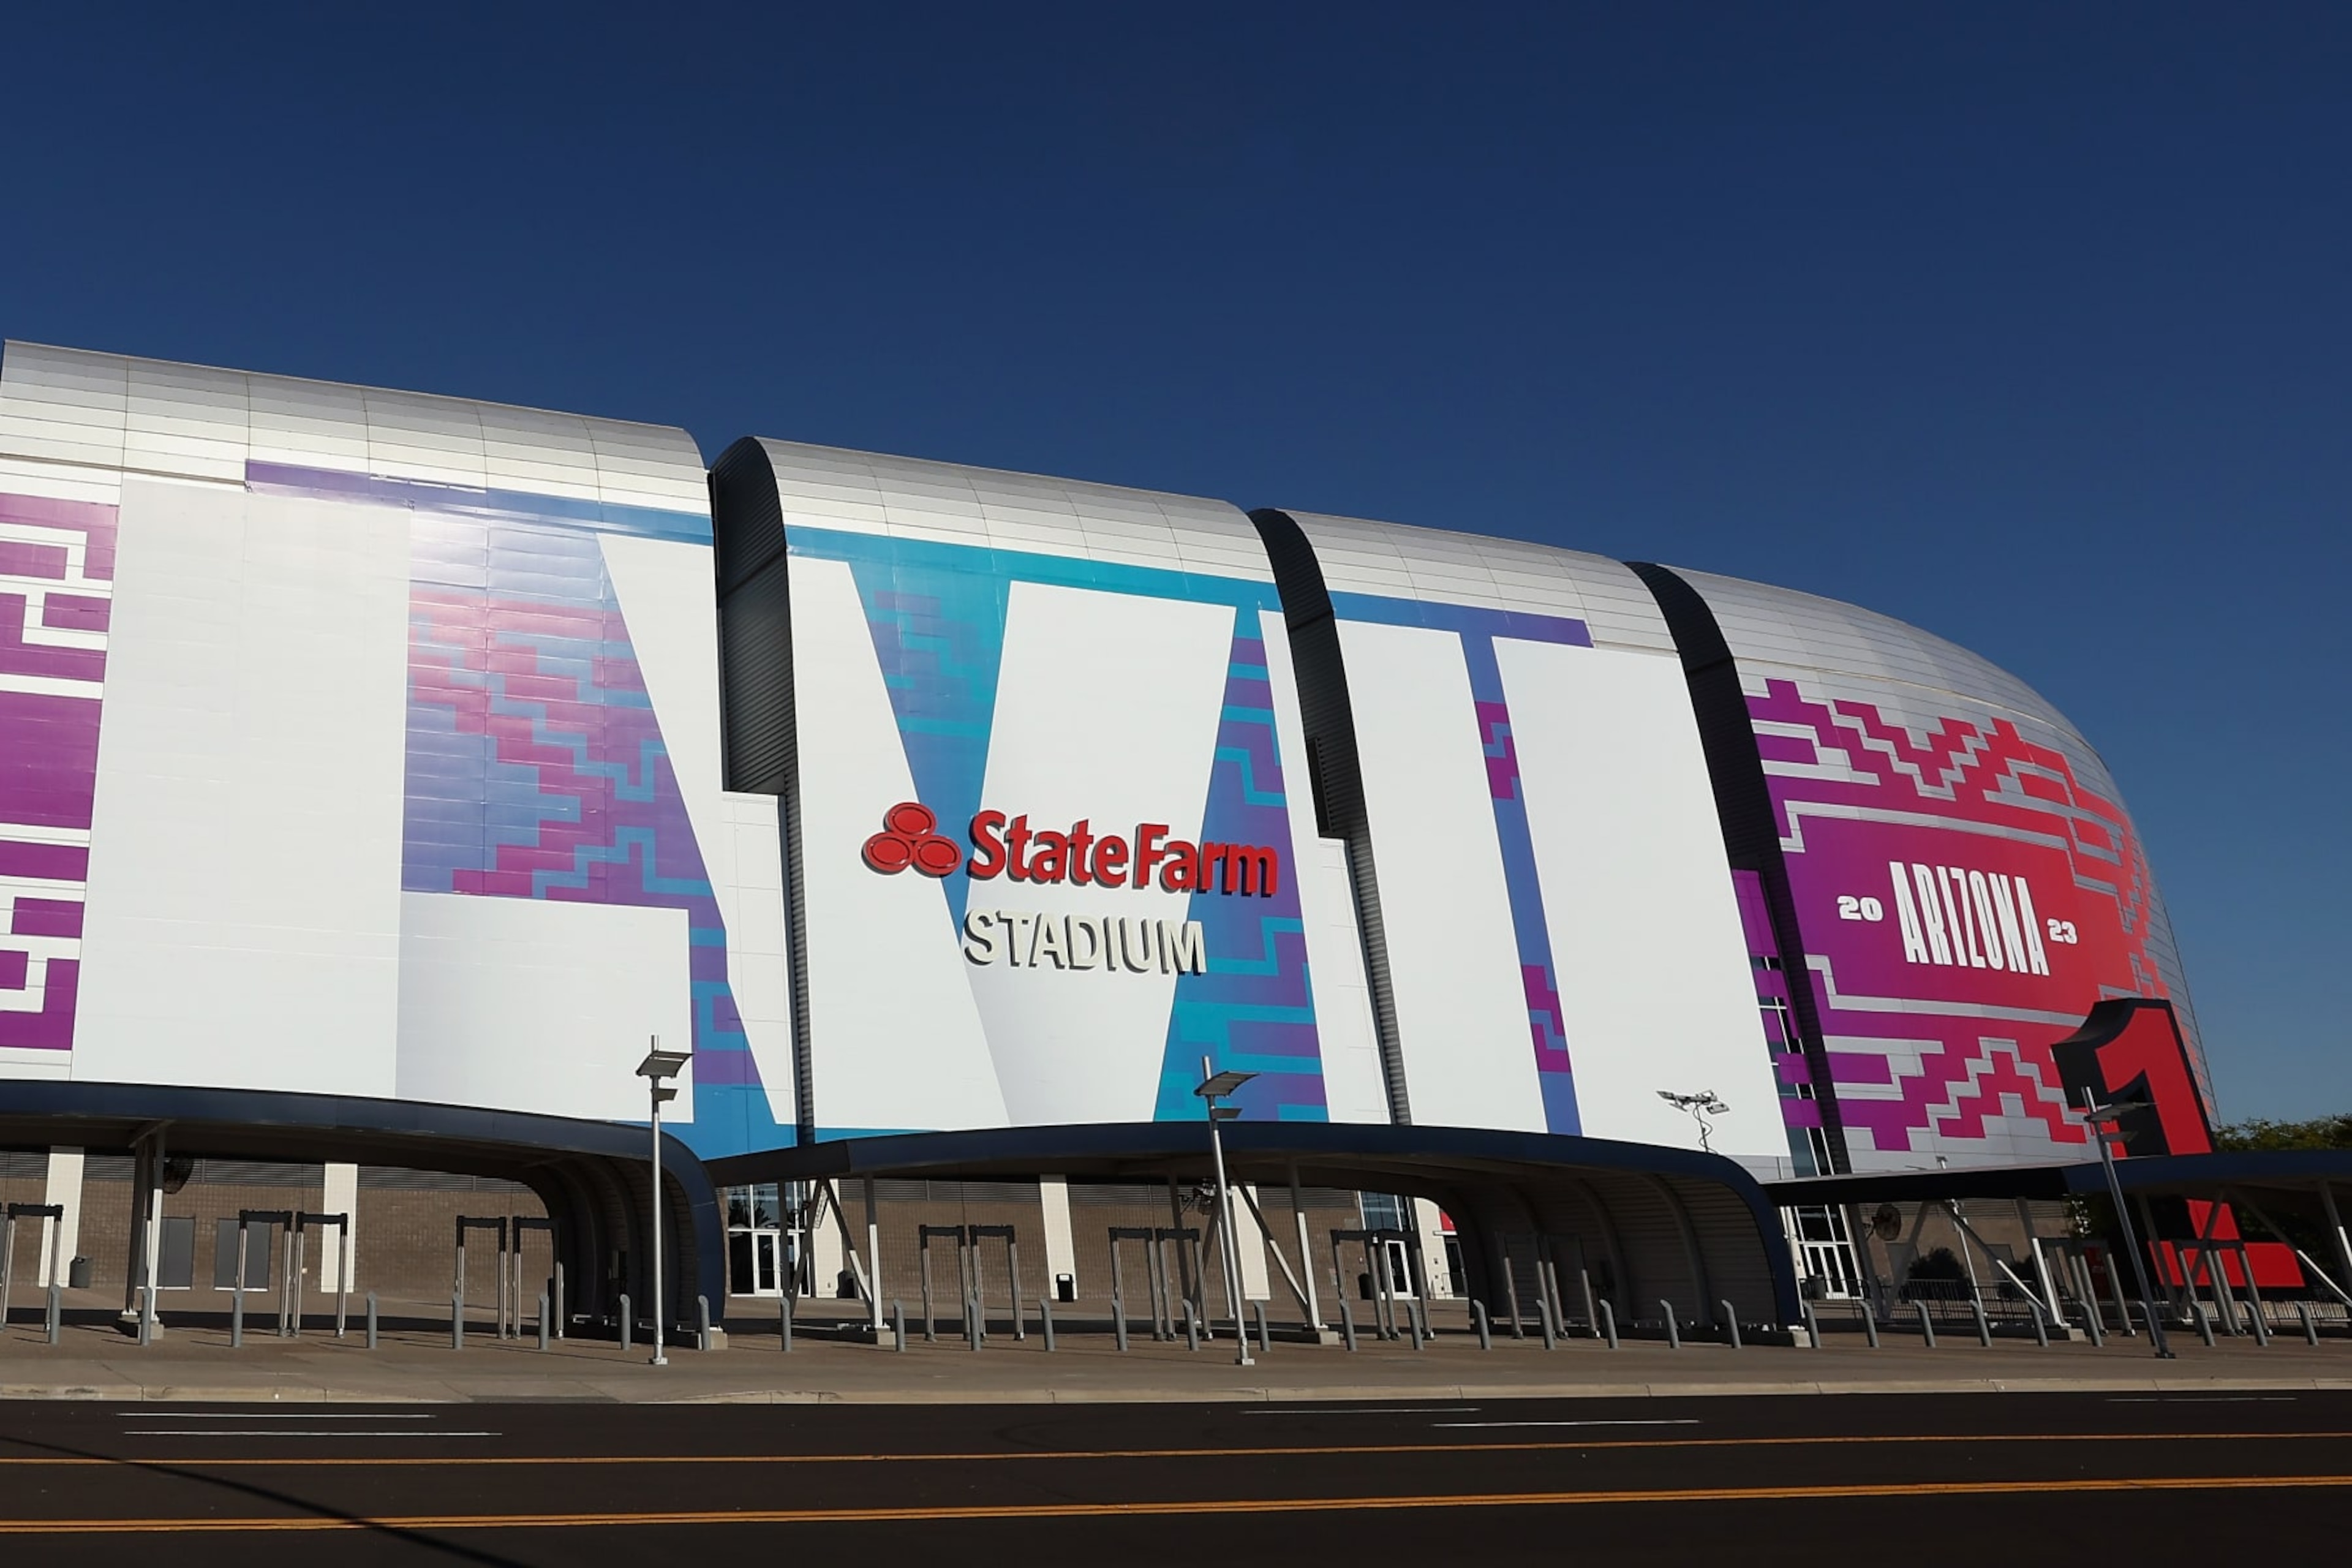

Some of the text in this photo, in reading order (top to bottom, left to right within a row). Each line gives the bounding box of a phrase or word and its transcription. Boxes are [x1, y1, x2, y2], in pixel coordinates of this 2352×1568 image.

[964, 908, 1207, 976] STADIUM
[1838, 861, 2078, 976] 20 ARIZONA 23
